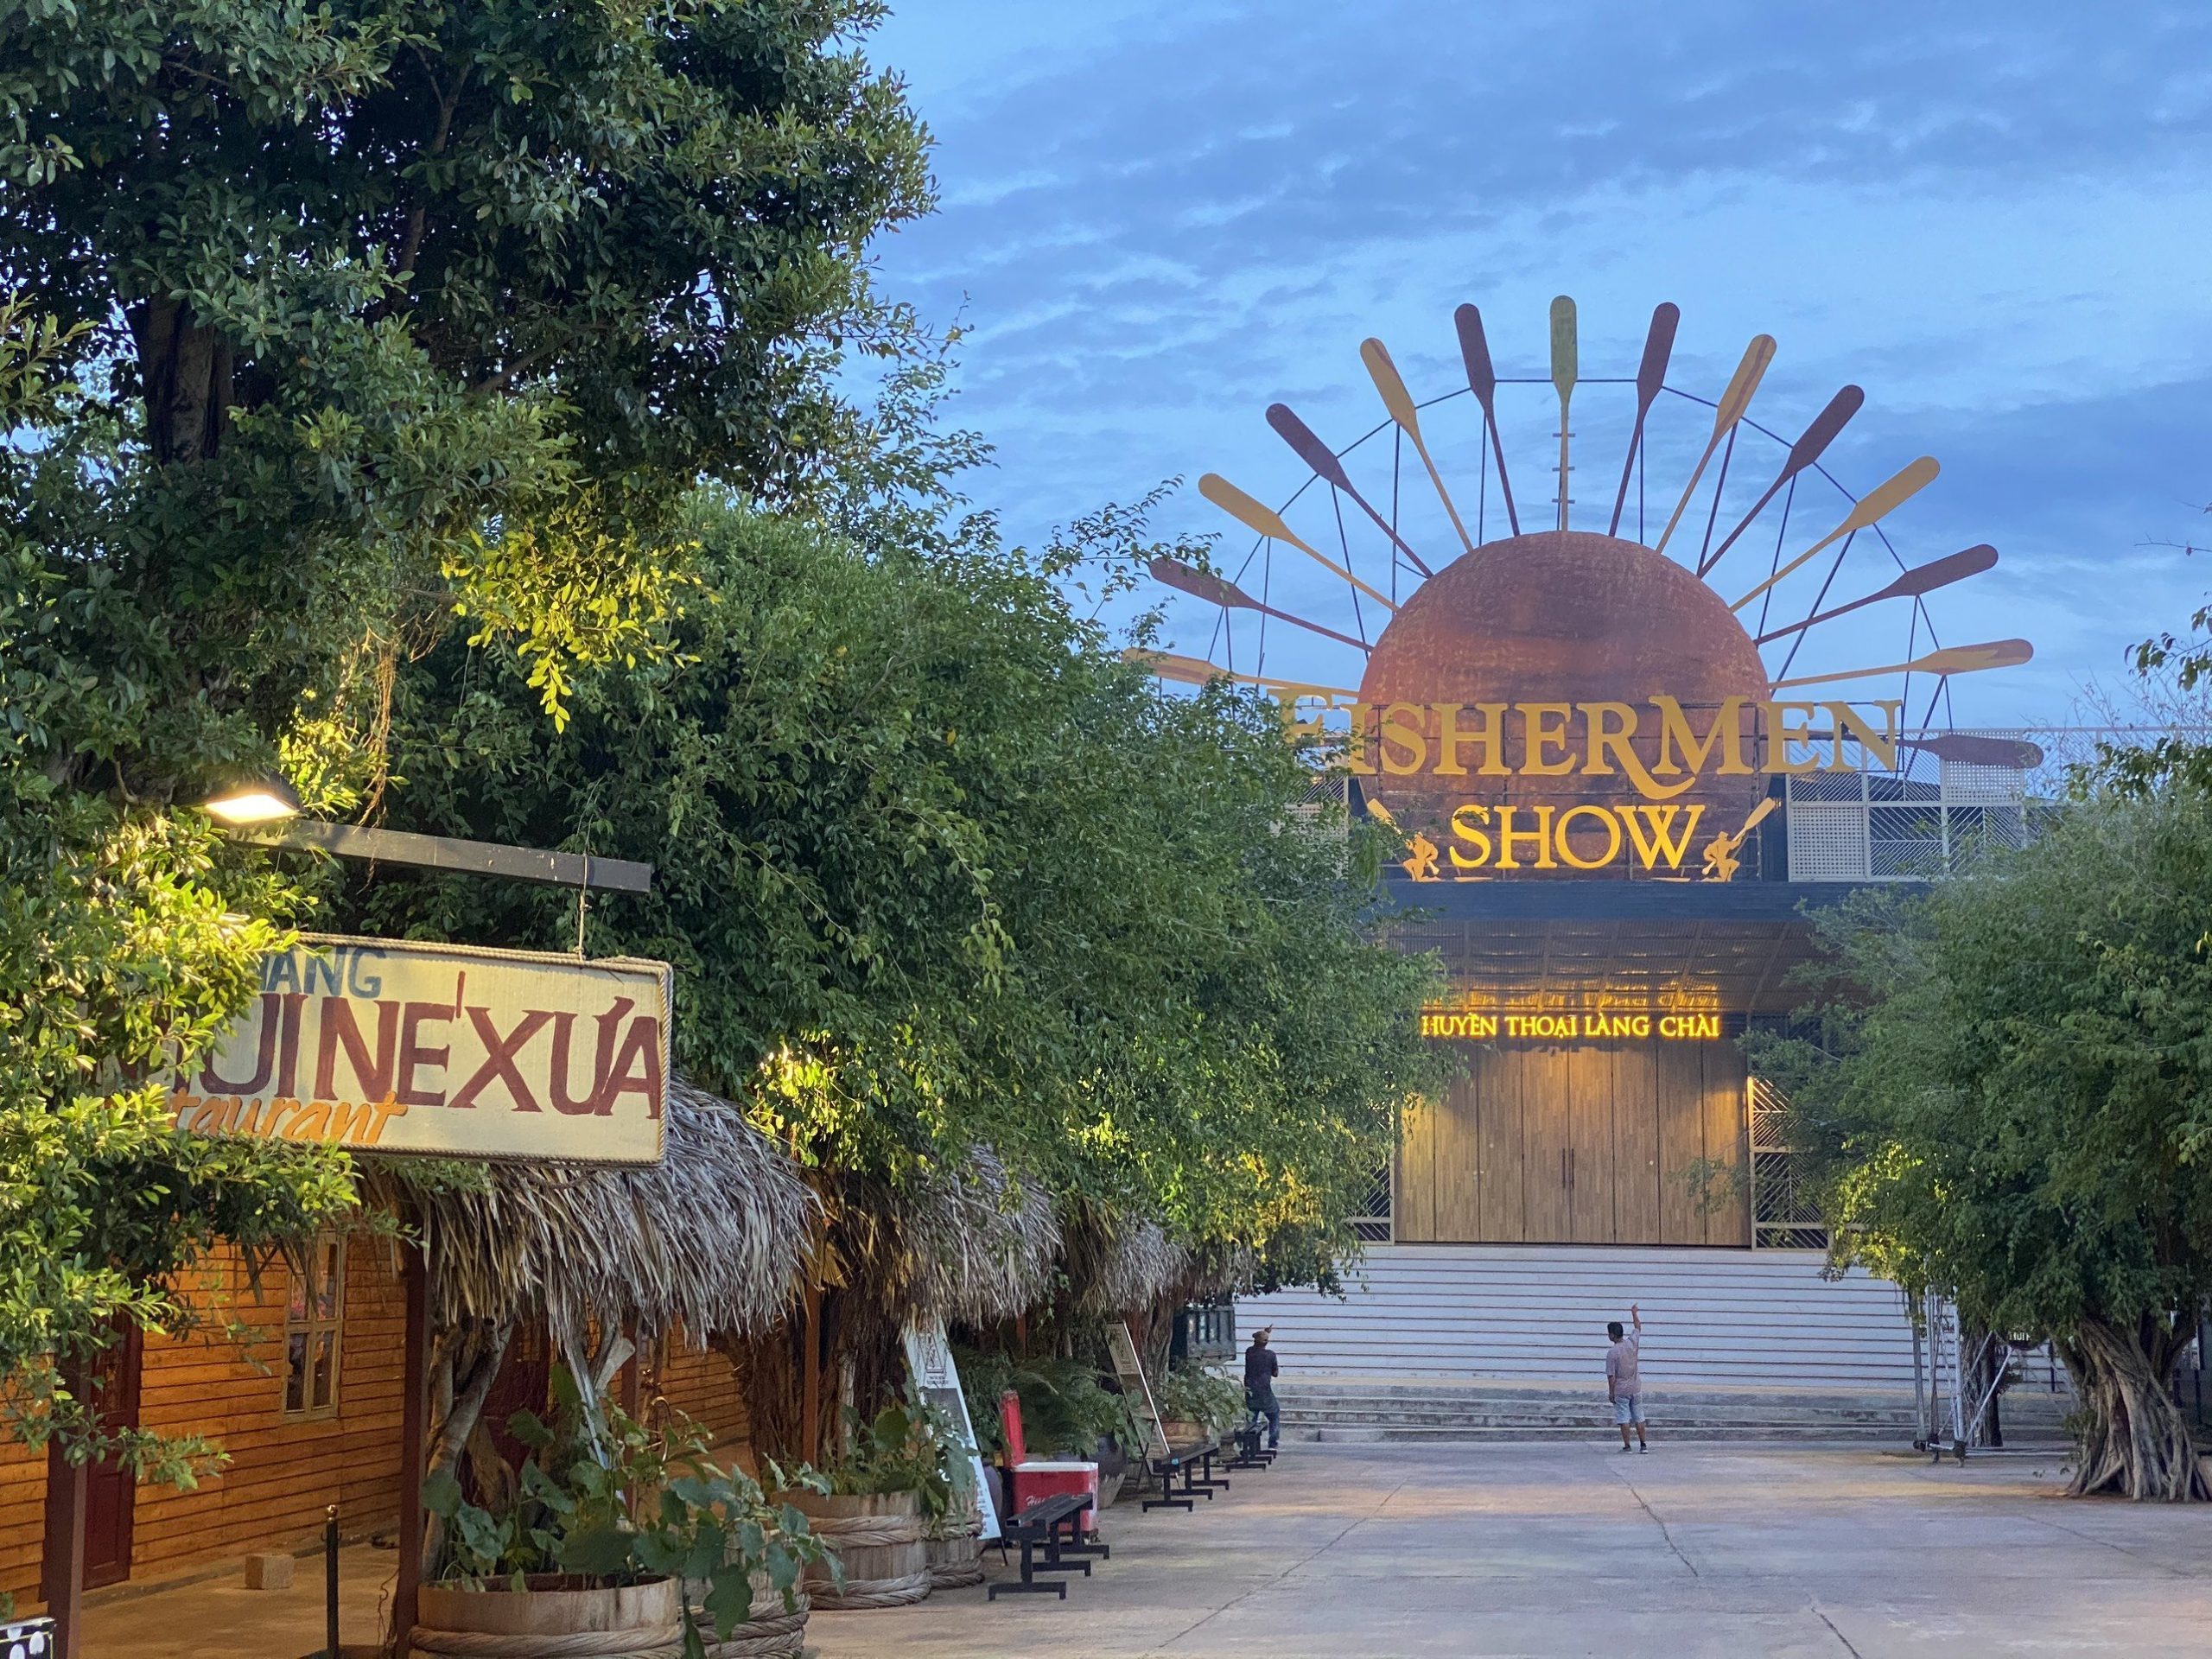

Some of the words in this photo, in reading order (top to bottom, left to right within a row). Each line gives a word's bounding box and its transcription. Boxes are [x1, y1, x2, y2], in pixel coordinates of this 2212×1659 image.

[1267, 688, 1903, 800] FISHERMEN
[1449, 804, 1706, 871] SHOW
[258, 947, 386, 999] ANG
[1503, 1014, 1578, 1039] THOẠI
[1585, 1013, 1649, 1037] LÀNG
[1659, 1013, 1719, 1038] CHÀI
